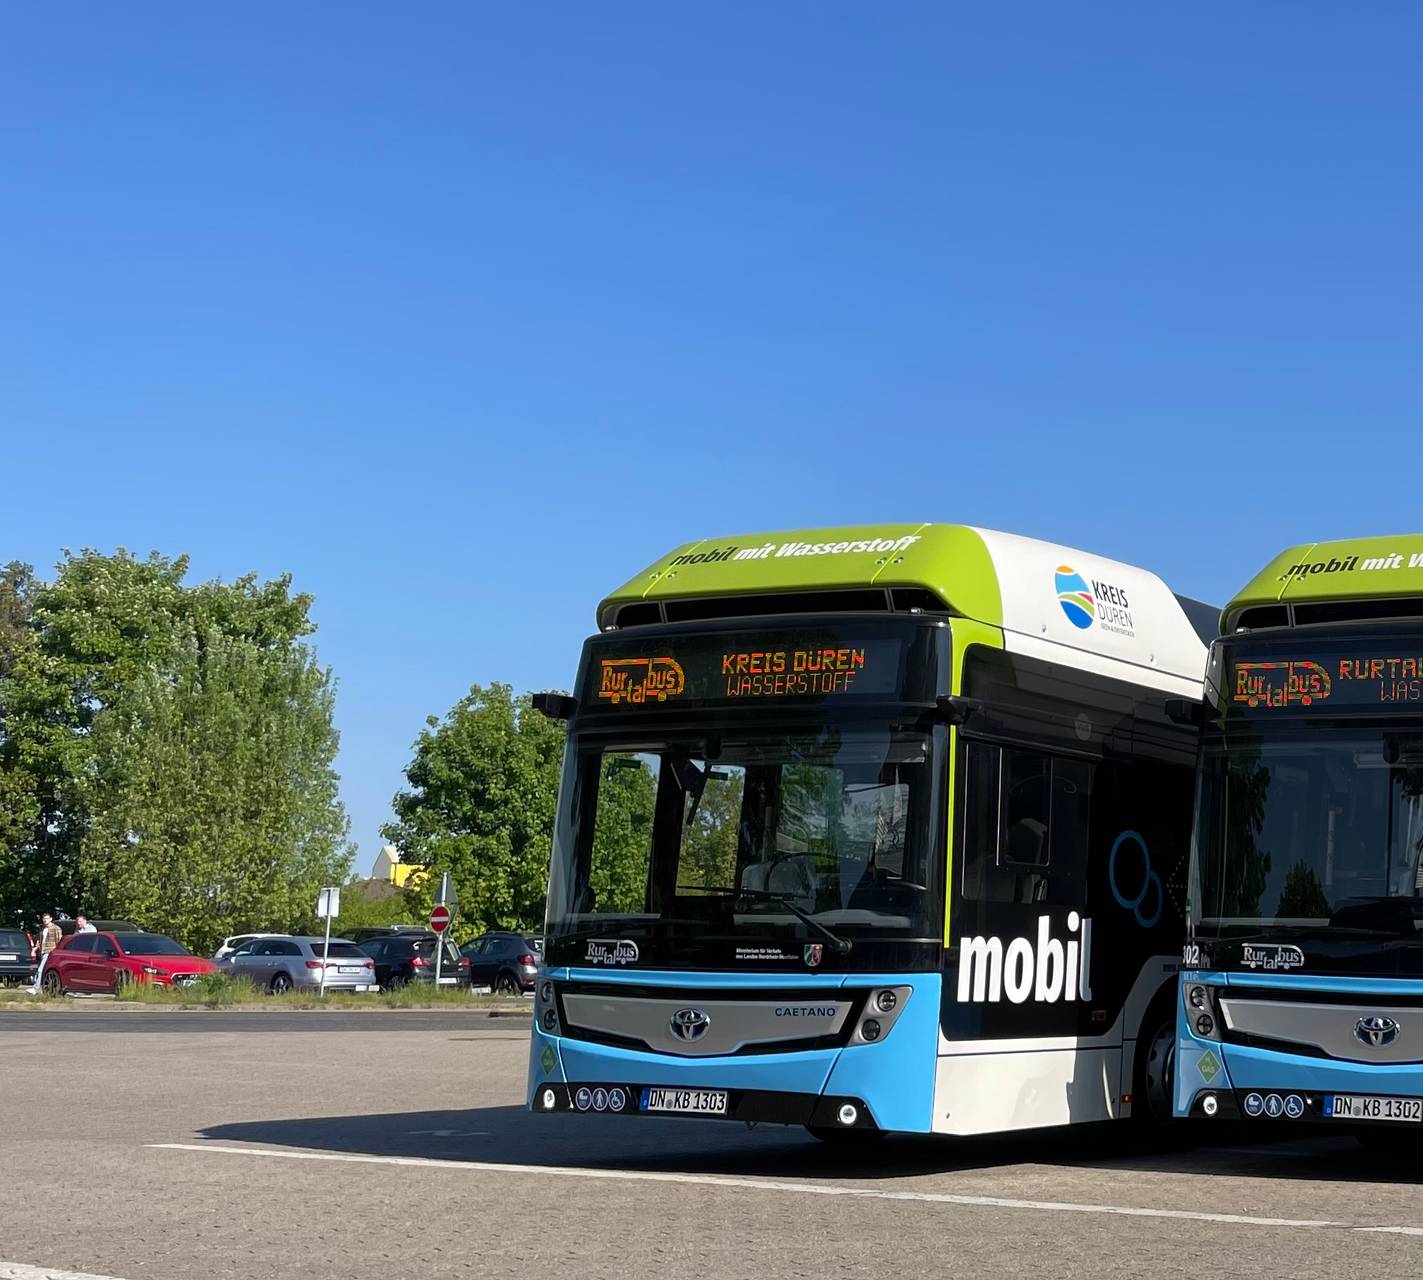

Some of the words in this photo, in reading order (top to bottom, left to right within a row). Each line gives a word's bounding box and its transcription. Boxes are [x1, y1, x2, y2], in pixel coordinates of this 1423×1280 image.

[670, 546, 739, 566] mobil
[733, 542, 777, 561] mit
[775, 535, 923, 558] Wasserstoff
[1288, 556, 1359, 575] mobil
[1360, 553, 1404, 571] mit
[1091, 579, 1128, 608] KREIS
[722, 652, 786, 675] KREIS
[793, 649, 866, 672] DÜREN
[727, 672, 856, 696] WASSERSTOFF
[957, 911, 1092, 1003] mobil
[775, 1007, 836, 1017] CAETANO
[649, 1090, 666, 1107] DN
[674, 1091, 690, 1109] KB
[693, 1092, 726, 1111] 1303
[1334, 1097, 1352, 1115] DN
[1363, 1099, 1381, 1117] KB
[1384, 1101, 1420, 1119] 1302
